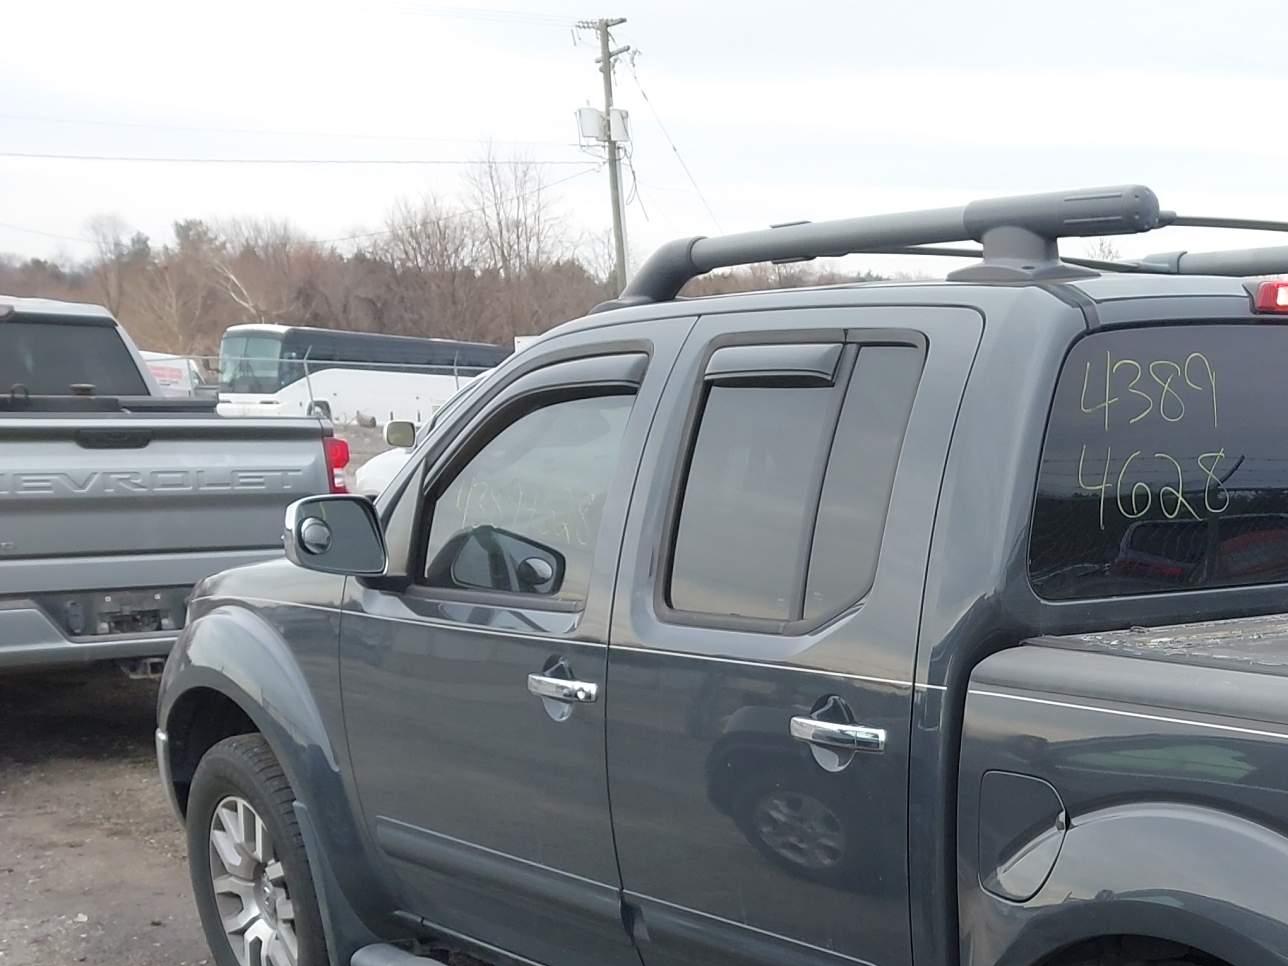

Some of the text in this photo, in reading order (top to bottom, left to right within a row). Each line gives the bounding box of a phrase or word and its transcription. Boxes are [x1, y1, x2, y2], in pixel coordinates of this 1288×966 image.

[1080, 350, 1219, 432] 4389
[0, 468, 303, 495] EVROLET
[1078, 444, 1230, 531] 4628
